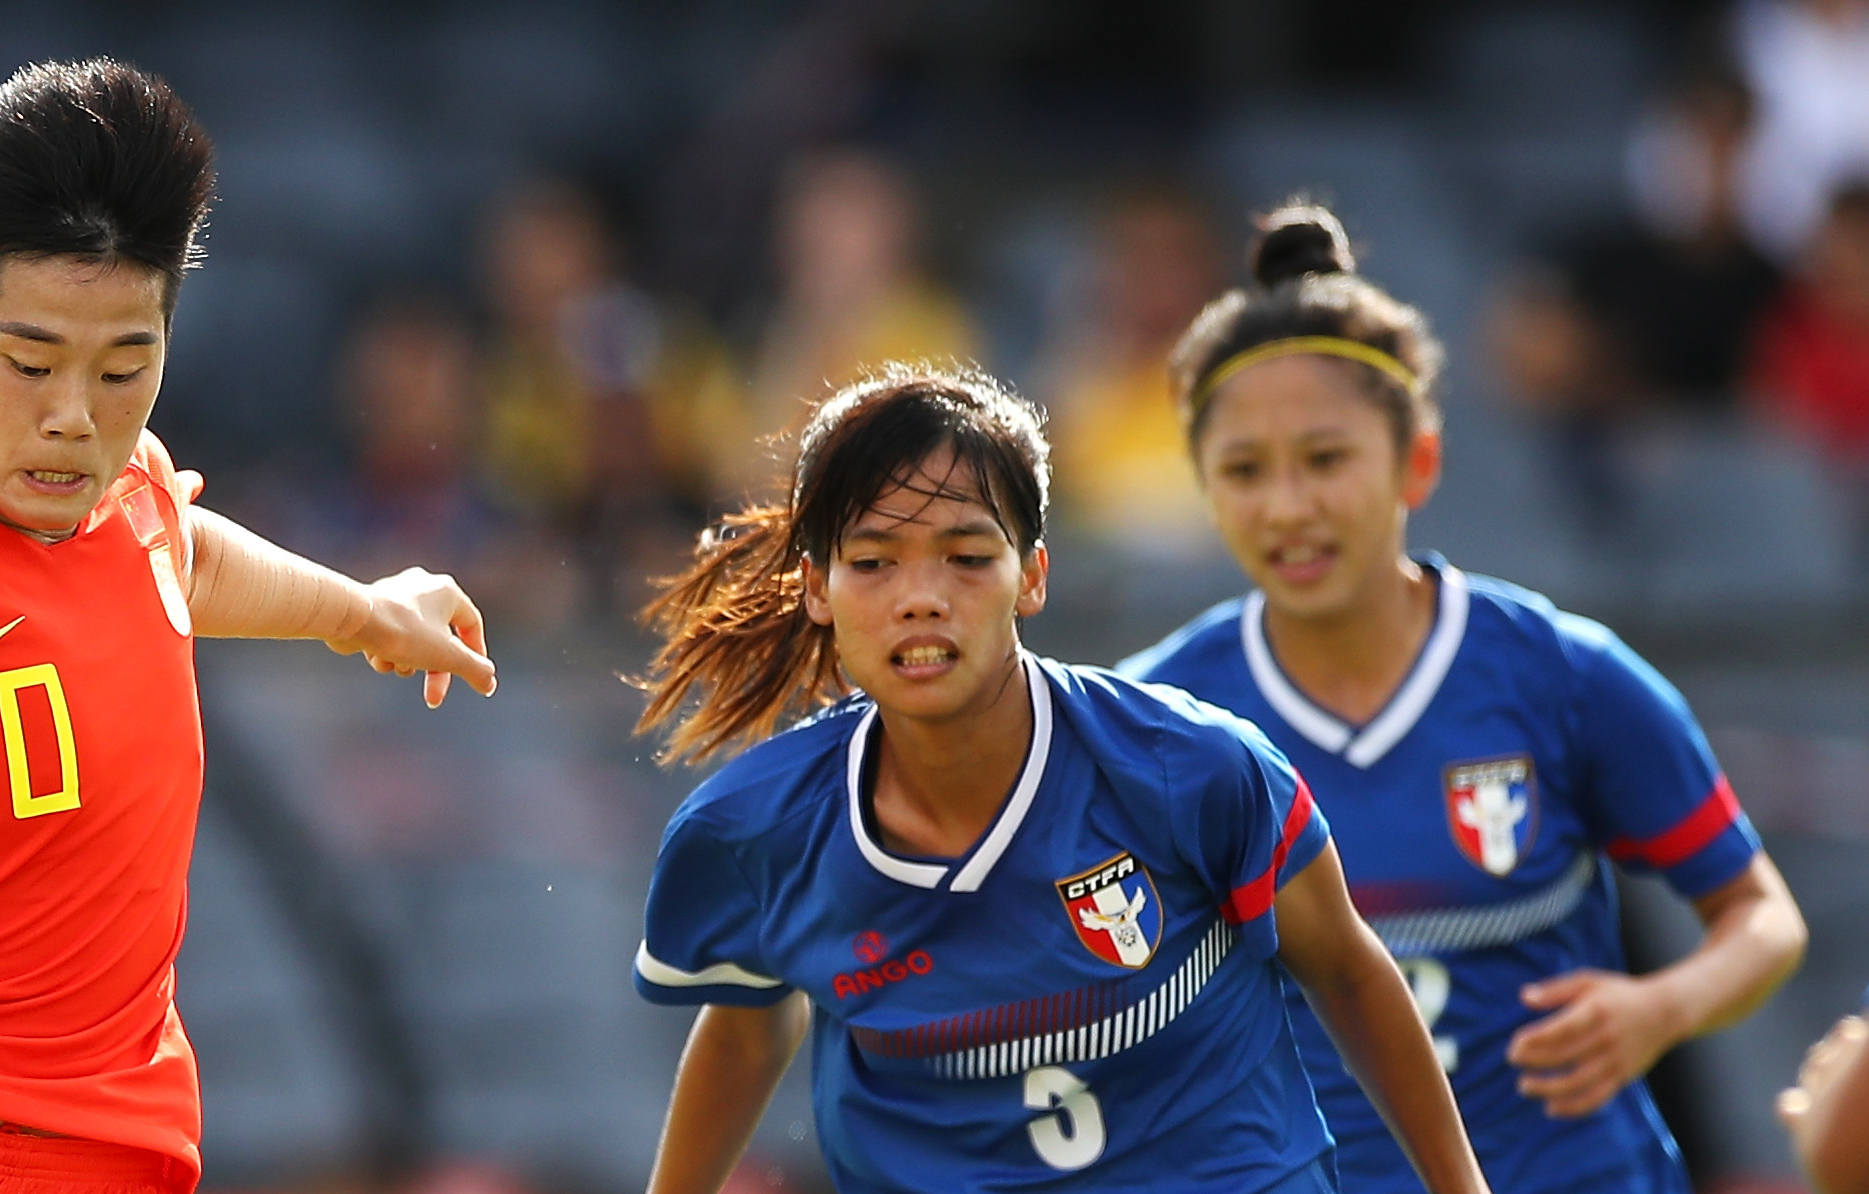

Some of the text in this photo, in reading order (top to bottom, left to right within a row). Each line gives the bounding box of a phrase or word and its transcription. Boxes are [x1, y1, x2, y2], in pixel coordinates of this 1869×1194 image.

[1068, 857, 1134, 899] CTFA
[833, 951, 933, 1000] ANGO
[1024, 1065, 1107, 1171] 3
